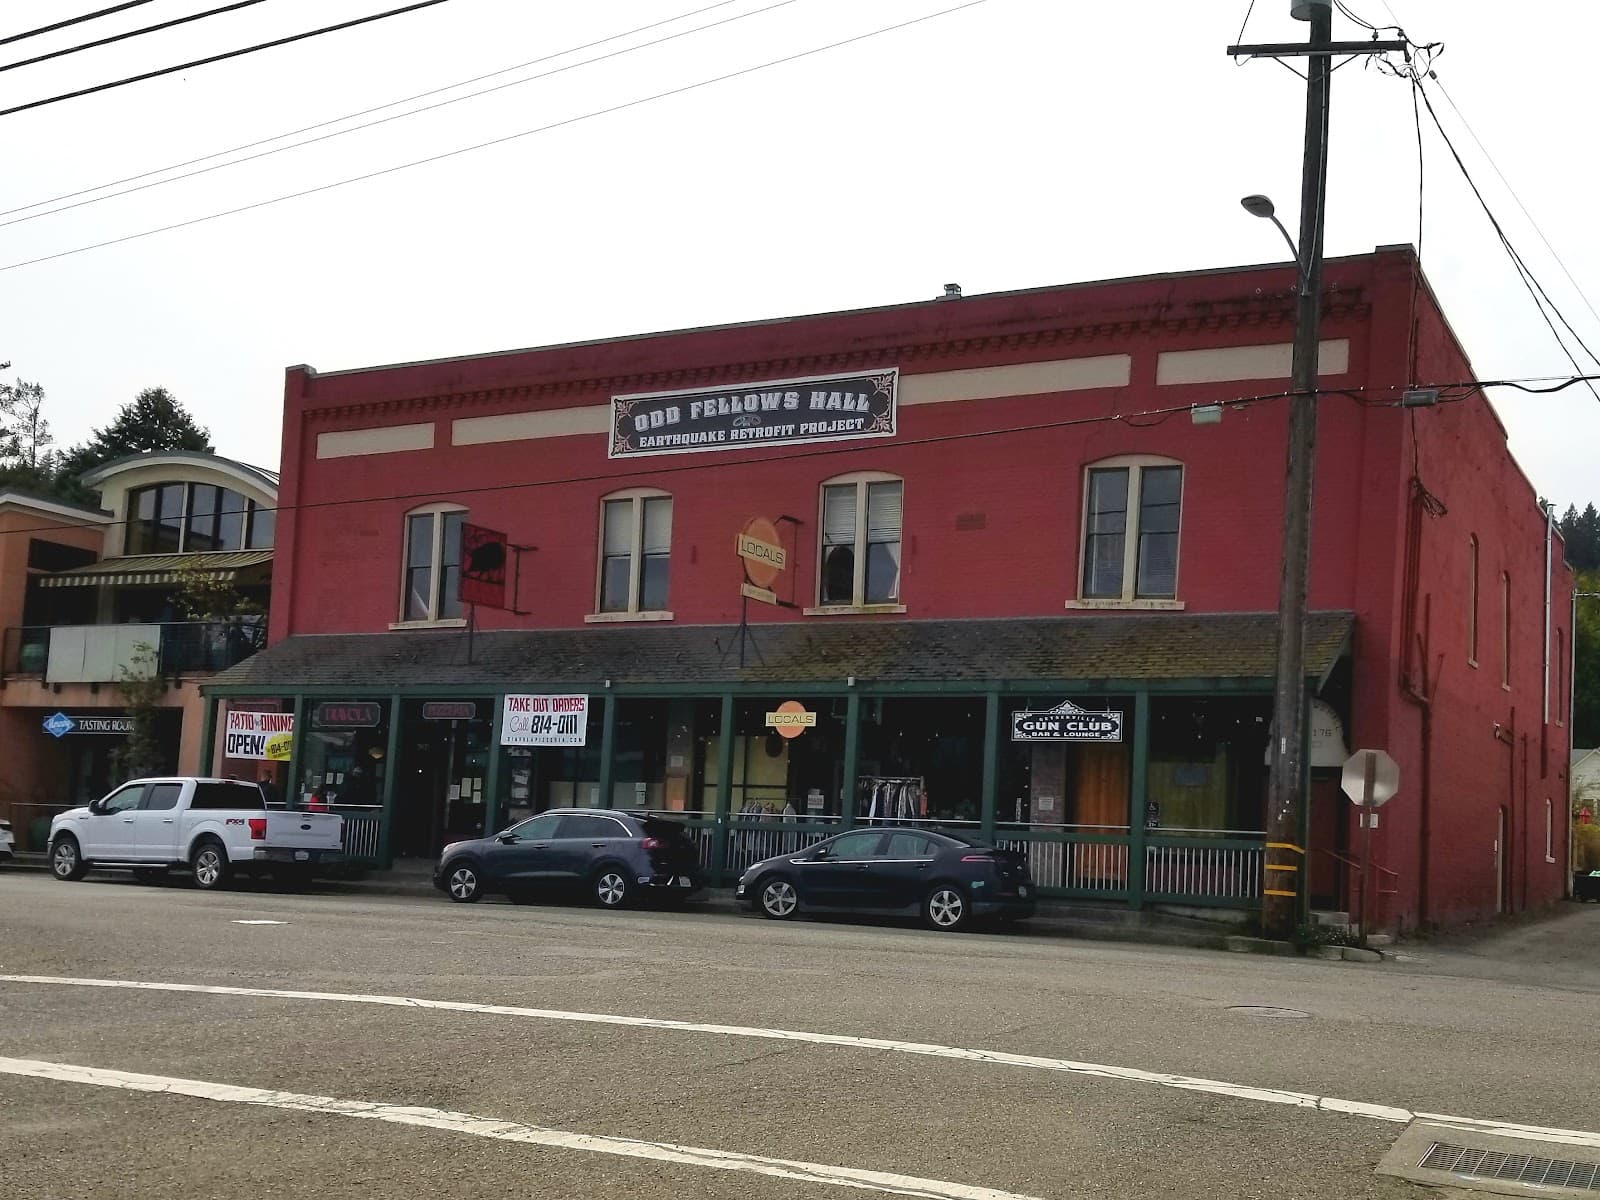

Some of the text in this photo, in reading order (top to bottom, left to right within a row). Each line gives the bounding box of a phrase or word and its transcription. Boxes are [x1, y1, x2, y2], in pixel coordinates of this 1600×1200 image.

[634, 391, 870, 432] ODD FELLOWS HALL
[639, 417, 864, 448] EARTHQUAKE RETROFIT PROJECT
[741, 539, 783, 564] LOCALS
[508, 697, 585, 712] TAKE OUT ORDERS
[79, 719, 110, 731] TASTING
[230, 713, 254, 731] PATIO
[509, 714, 577, 734] Call 814-0111
[768, 715, 813, 724] LOCALS
[1022, 721, 1112, 731] GUN CLUB
[227, 733, 266, 756] OPEN!
